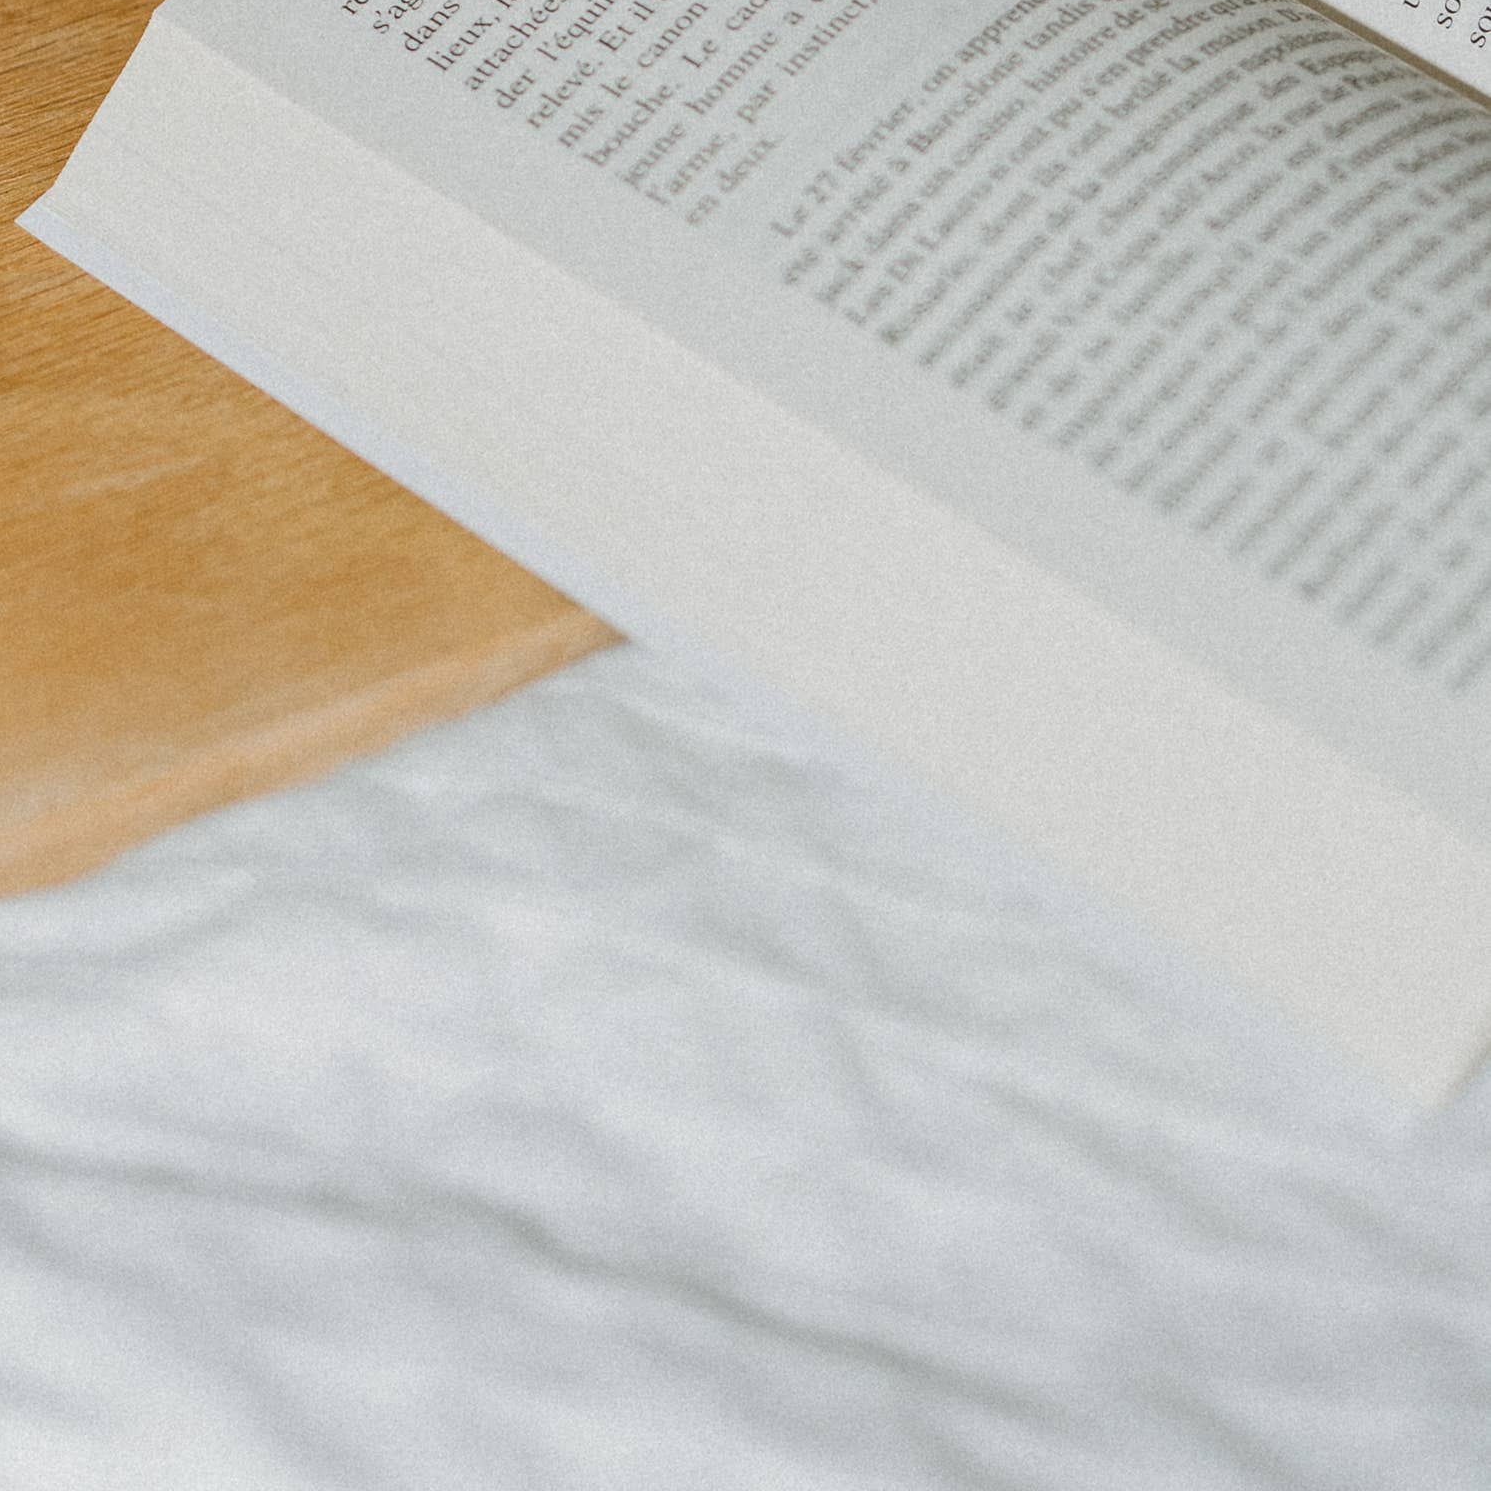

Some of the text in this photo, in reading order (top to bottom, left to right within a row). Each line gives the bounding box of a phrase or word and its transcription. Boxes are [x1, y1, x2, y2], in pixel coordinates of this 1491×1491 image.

[427, 15, 500, 71] lieux,
[527, 60, 604, 128] relevé.
[597, 25, 634, 52] Et
[631, 1, 656, 21] il
[684, 30, 777, 116] homme
[783, 10, 803, 25] a
[1022, 0, 1096, 50] tandis
[496, 71, 535, 108] der
[559, 105, 604, 147] mis
[602, 75, 632, 99] le
[637, 1, 708, 68] canon
[584, 83, 680, 166] bouche.
[681, 38, 718, 68] Le
[738, 83, 776, 124] par
